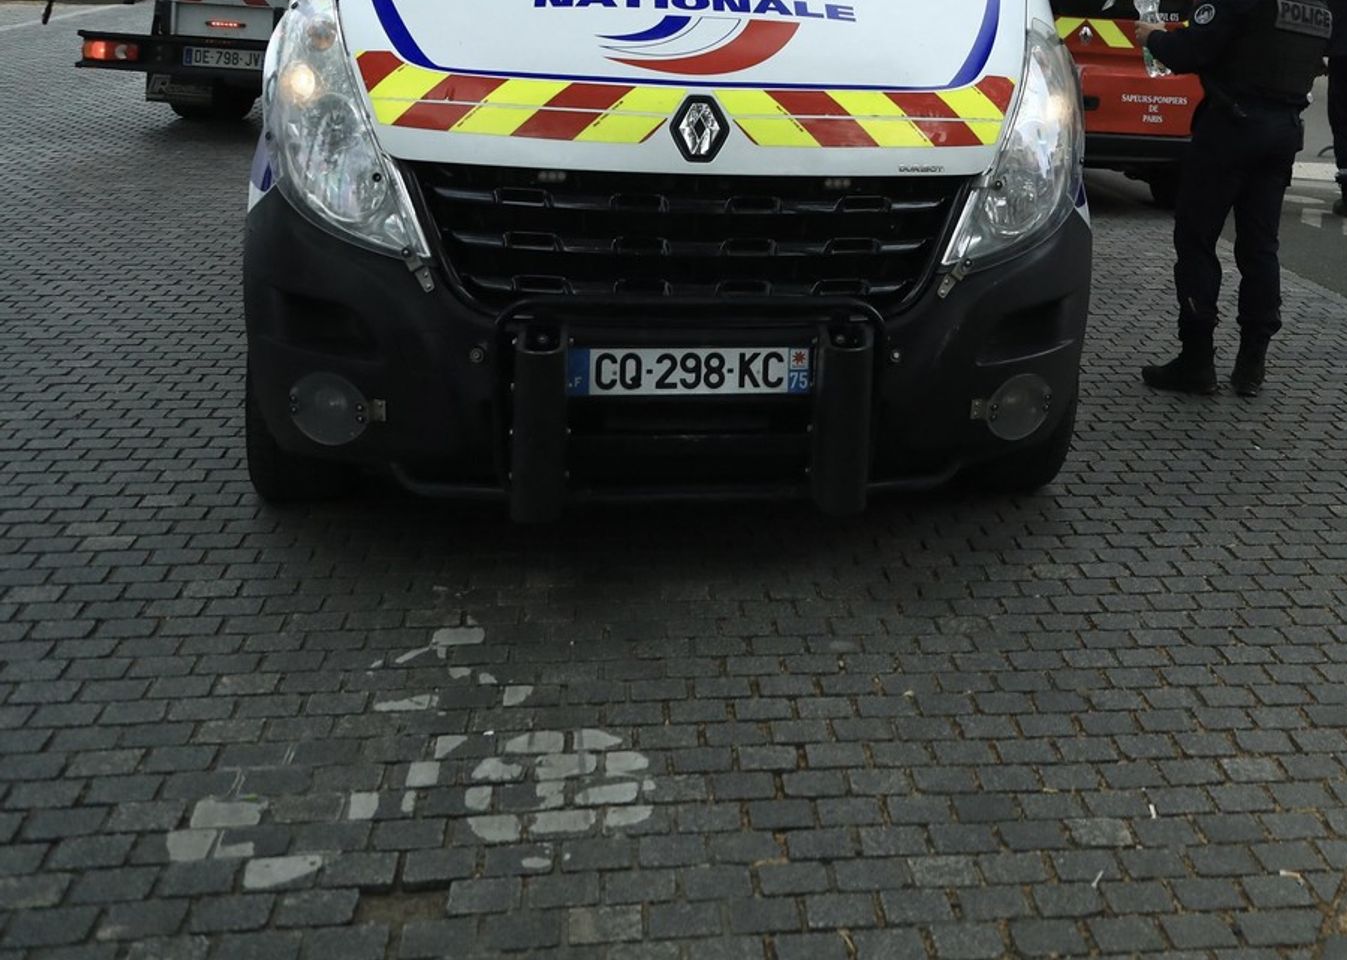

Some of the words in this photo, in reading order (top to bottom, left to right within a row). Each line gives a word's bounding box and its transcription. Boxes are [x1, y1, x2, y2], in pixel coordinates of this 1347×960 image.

[1281, 1, 1330, 28] POLICE
[194, 49, 260, 67] DE-798-JV
[1121, 94, 1188, 105] SAPEURS-POMPIERS
[1148, 104, 1159, 113] DE
[1142, 114, 1163, 123] PARIS
[595, 352, 784, 390] CQ-298-KC
[790, 372, 808, 389] 75
